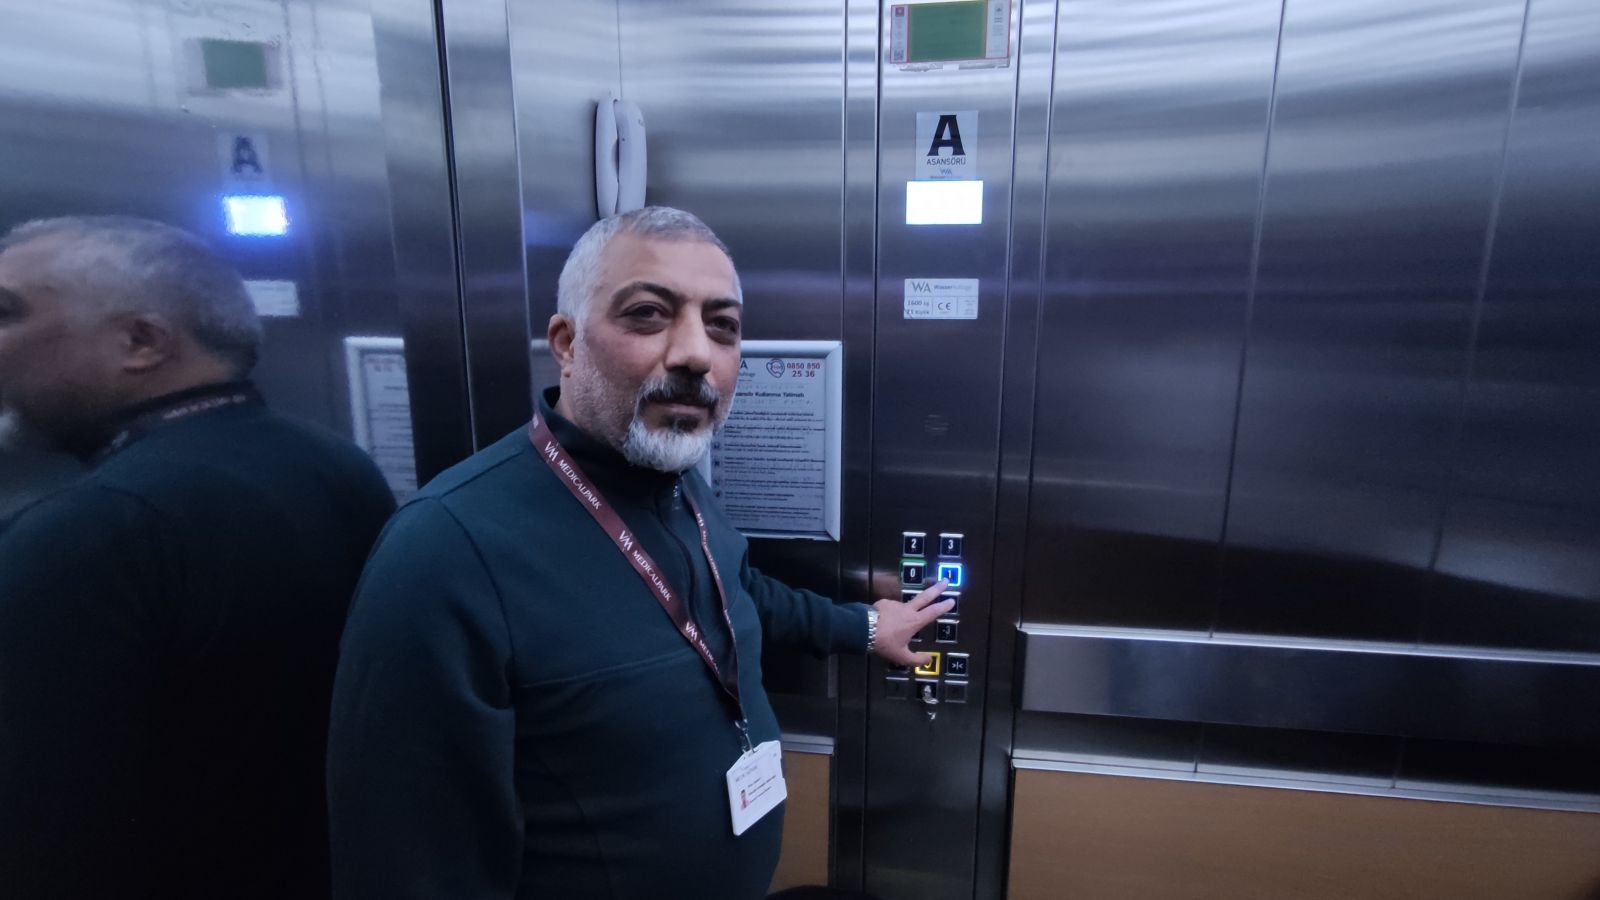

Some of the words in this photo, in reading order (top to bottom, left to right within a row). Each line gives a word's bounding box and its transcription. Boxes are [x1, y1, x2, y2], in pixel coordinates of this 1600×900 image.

[927, 114, 966, 156] A
[927, 156, 967, 166] ASANSÖRÜ
[912, 281, 932, 293] WA
[740, 360, 749, 369] A
[786, 362, 805, 370] 0850
[807, 362, 821, 370] 850
[792, 370, 802, 378] 25
[805, 370, 815, 378] 36
[556, 459, 603, 511] MEDICALPARK
[911, 538, 917, 549] 2
[948, 539, 954, 550] 3
[631, 549, 673, 602] MEDICALPARK
[910, 567, 916, 578] 0
[947, 569, 952, 579] 1
